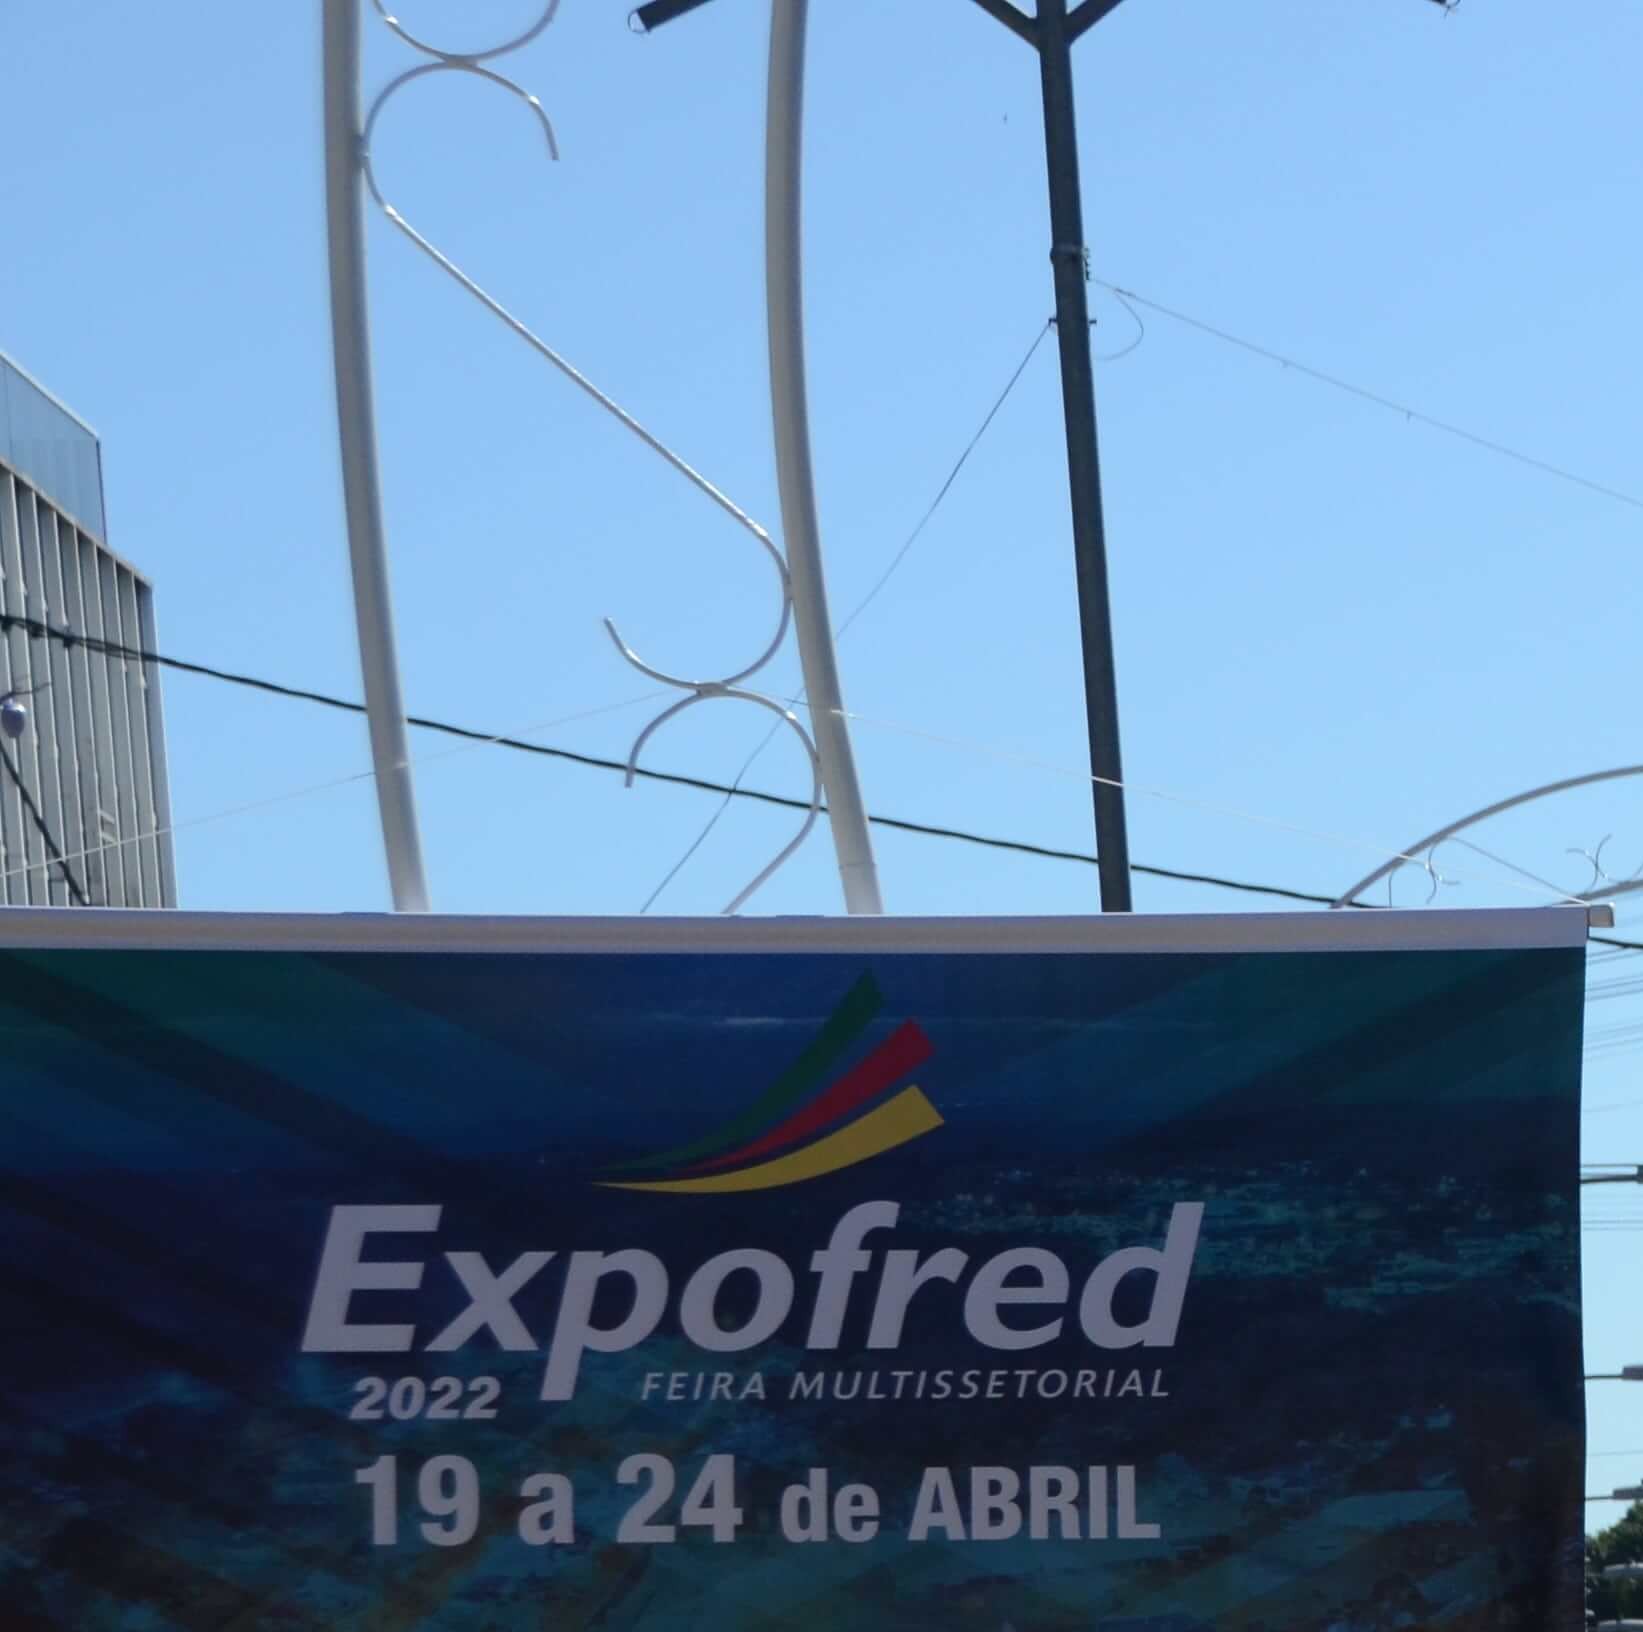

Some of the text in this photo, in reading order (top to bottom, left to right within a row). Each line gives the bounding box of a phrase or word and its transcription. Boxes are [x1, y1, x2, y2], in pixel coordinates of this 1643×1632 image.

[300, 1201, 1204, 1401] Expofred
[351, 1376, 499, 1421] 2022
[640, 1368, 1171, 1402] FEIRA MULTISSETORIAL
[352, 1451, 1161, 1548] 19 a 24 de ABRIL
